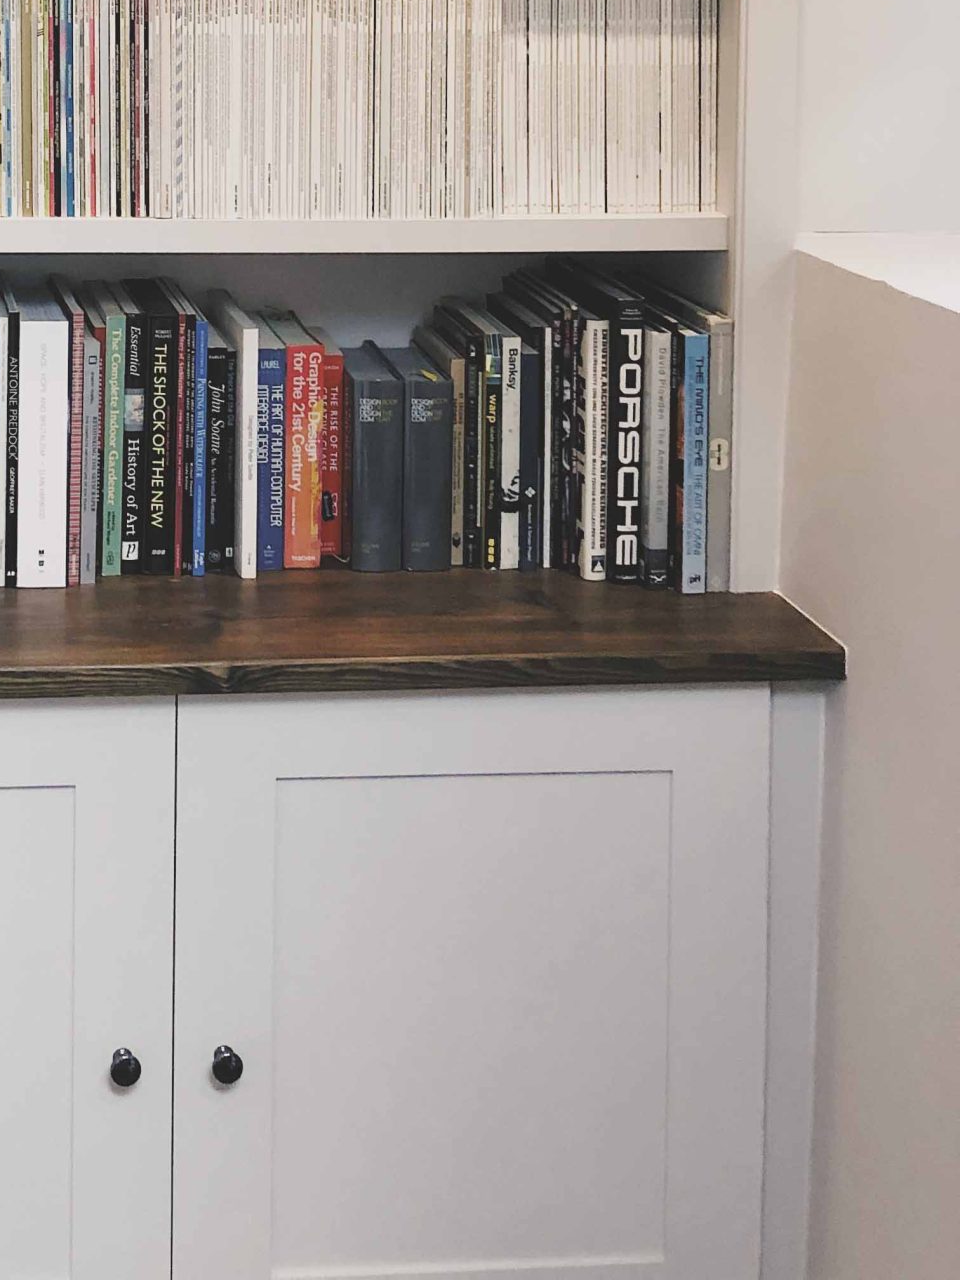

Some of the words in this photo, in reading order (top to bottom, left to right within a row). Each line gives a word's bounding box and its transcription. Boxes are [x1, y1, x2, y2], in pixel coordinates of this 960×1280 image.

[110, 328, 122, 351] The
[129, 326, 141, 377] Essential
[154, 344, 168, 374] THE
[292, 352, 305, 372] for
[658, 347, 667, 375] David
[694, 356, 705, 385] THE
[8, 357, 18, 407] ANTOINE
[108, 353, 122, 407] Complete
[271, 384, 284, 403] THE
[292, 376, 305, 400] the
[306, 352, 322, 407] Graphic
[153, 376, 167, 431] SHOCK
[208, 380, 226, 415] John
[271, 404, 284, 420] ART
[486, 395, 497, 423] warp
[657, 379, 667, 420] Plowden
[109, 409, 120, 448] Indoor
[271, 424, 284, 436] OF
[292, 403, 305, 432] 21st
[8, 409, 18, 460] PREDOCK
[152, 433, 166, 455] OF
[210, 418, 224, 455] Soane
[306, 410, 322, 462] Design
[616, 328, 642, 566] PORSCHE
[657, 427, 666, 445] The
[124, 438, 139, 492] History
[288, 433, 304, 492] Century
[694, 439, 704, 467] EYE
[107, 450, 119, 506] Gardener
[151, 457, 165, 487] THE
[270, 437, 284, 527] HUMAN-COMPUTER
[126, 495, 139, 509] of
[151, 490, 165, 528] NEW
[126, 512, 138, 536] Art
